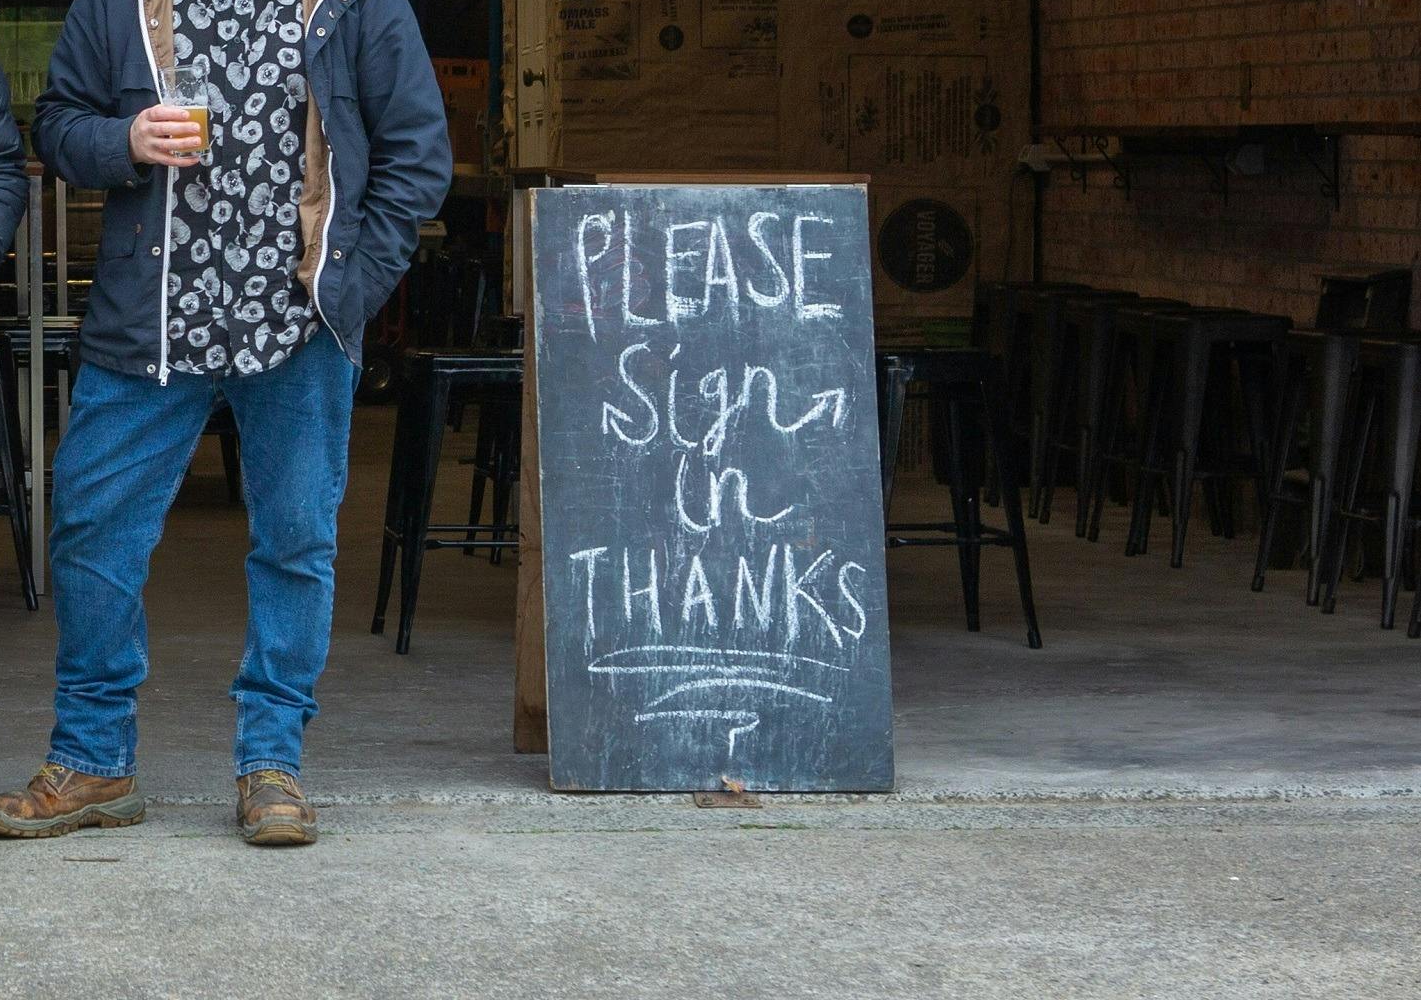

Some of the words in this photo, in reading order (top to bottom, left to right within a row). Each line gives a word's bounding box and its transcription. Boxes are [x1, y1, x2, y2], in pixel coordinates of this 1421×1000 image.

[559, 6, 609, 21] OMPASS
[576, 209, 844, 342] PLEASE
[915, 208, 937, 285] VOYAGER
[604, 341, 844, 456] Sign
[674, 453, 795, 533] in
[569, 542, 868, 650] THANKS
